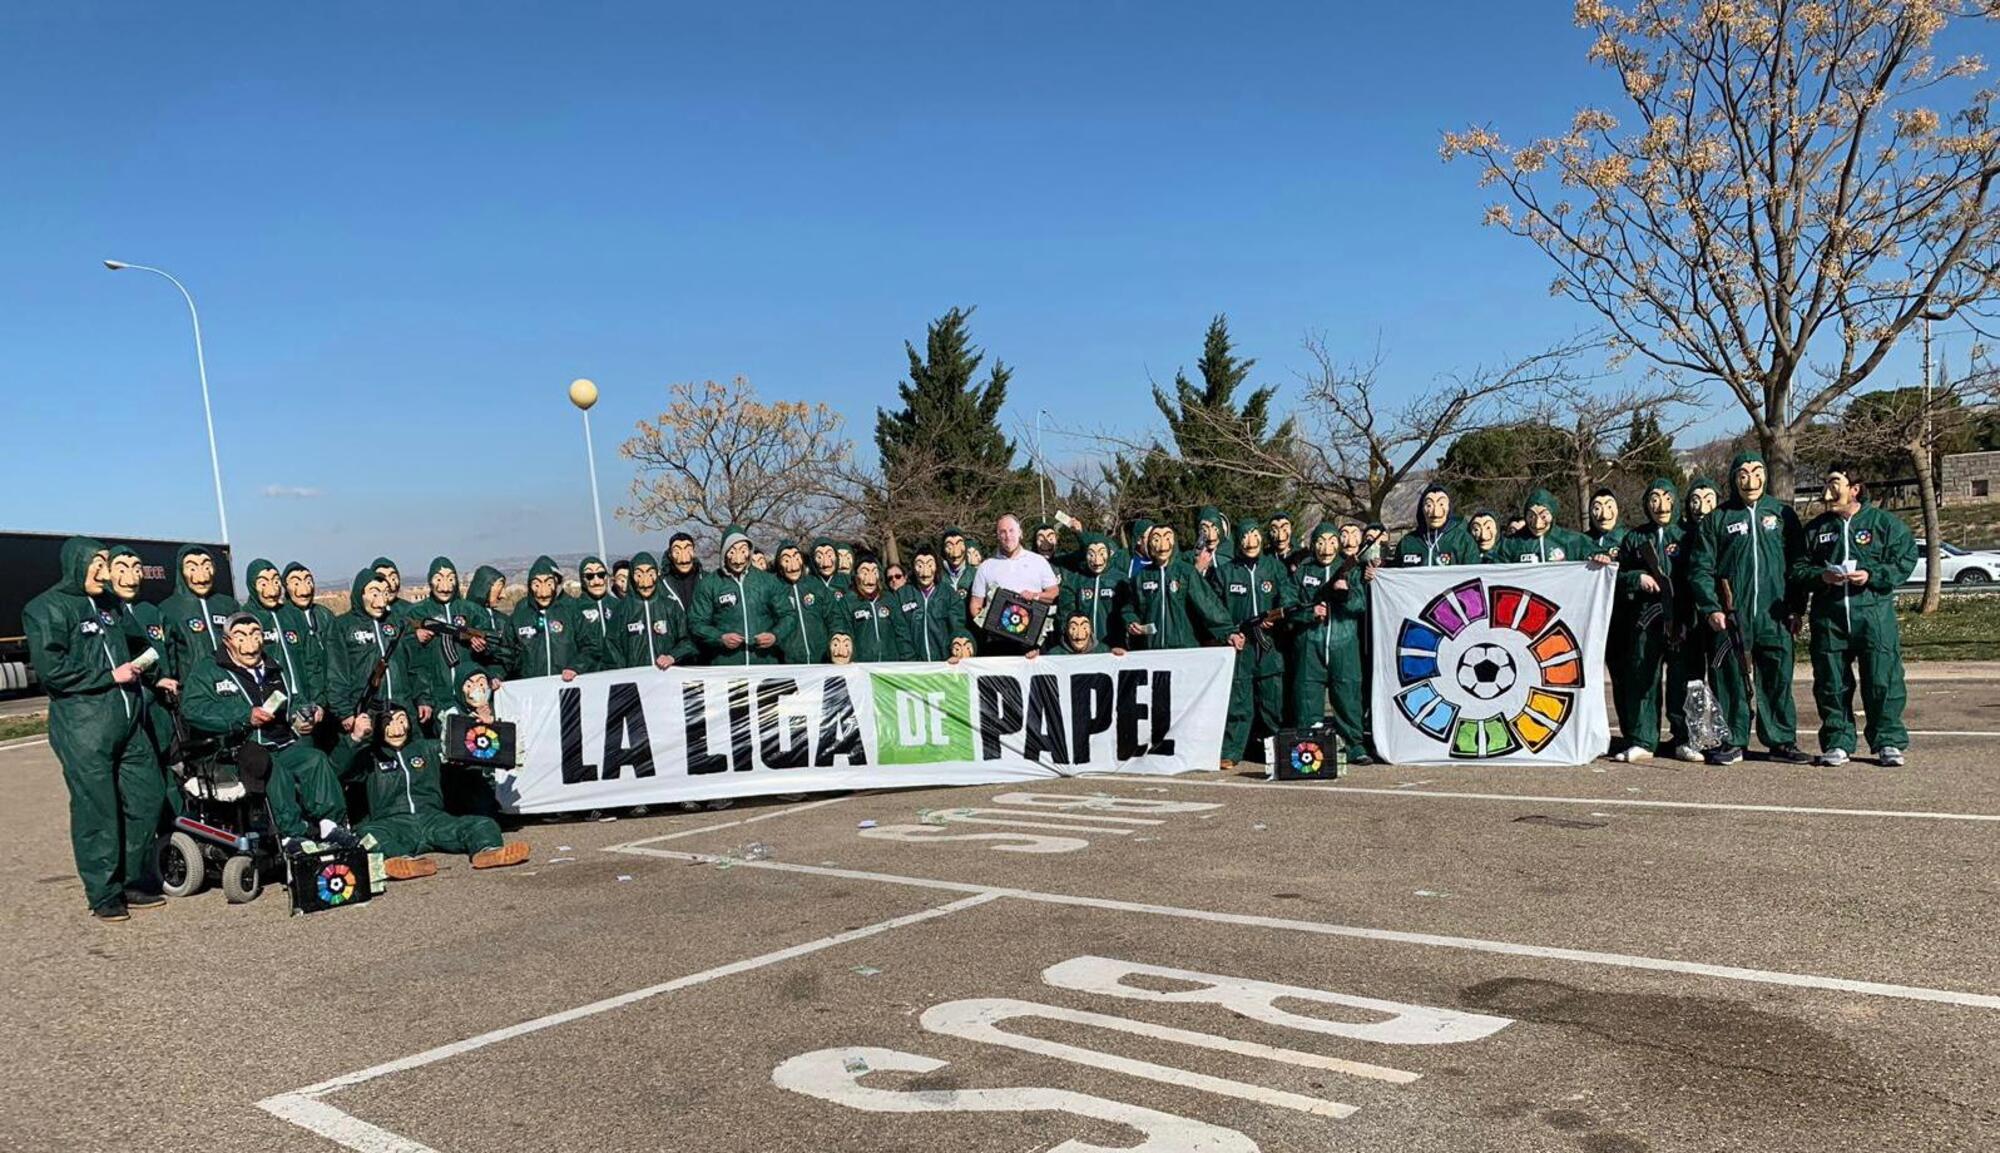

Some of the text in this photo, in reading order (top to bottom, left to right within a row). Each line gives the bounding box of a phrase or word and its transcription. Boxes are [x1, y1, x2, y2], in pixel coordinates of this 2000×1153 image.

[559, 669, 1175, 784] LA LIGA DE PAPEL
[857, 792, 1225, 853] BUS
[771, 955, 1517, 1153] BUS
